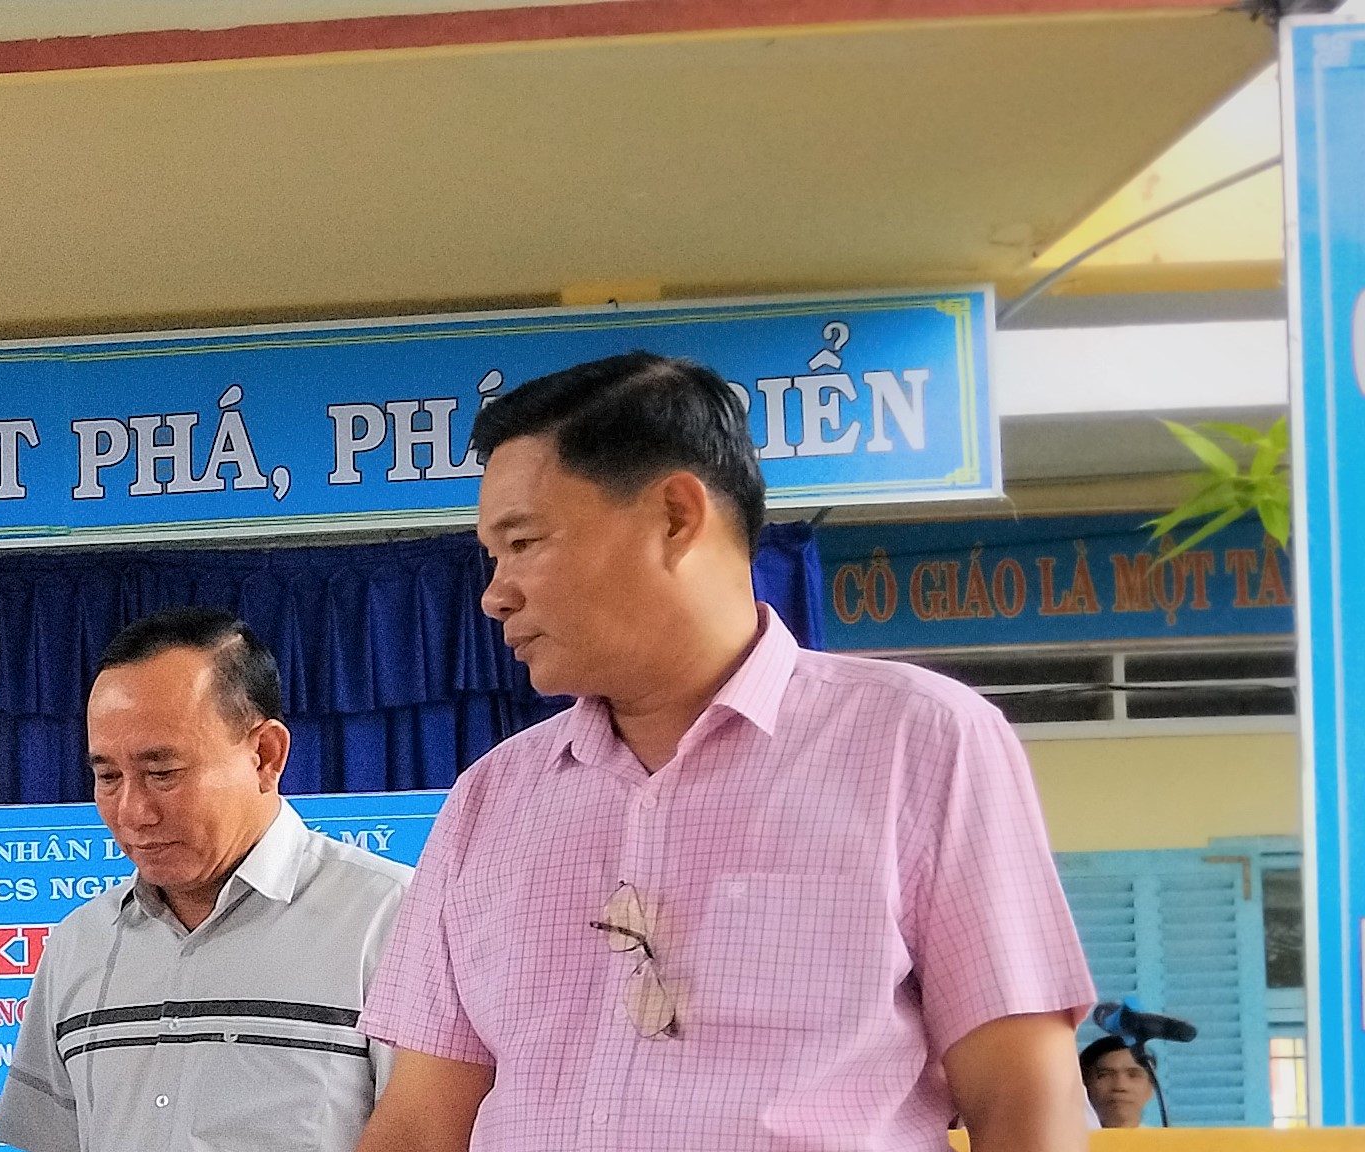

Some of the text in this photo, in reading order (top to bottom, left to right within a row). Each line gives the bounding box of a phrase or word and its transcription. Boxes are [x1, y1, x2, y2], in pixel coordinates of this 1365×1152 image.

[71, 384, 291, 501] PHÁ,
[729, 321, 931, 460] IỂN
[833, 545, 898, 624] CÔ
[909, 541, 1027, 622] GIÁO
[1110, 533, 1216, 627] MỘT
[339, 824, 396, 851] MỸ
